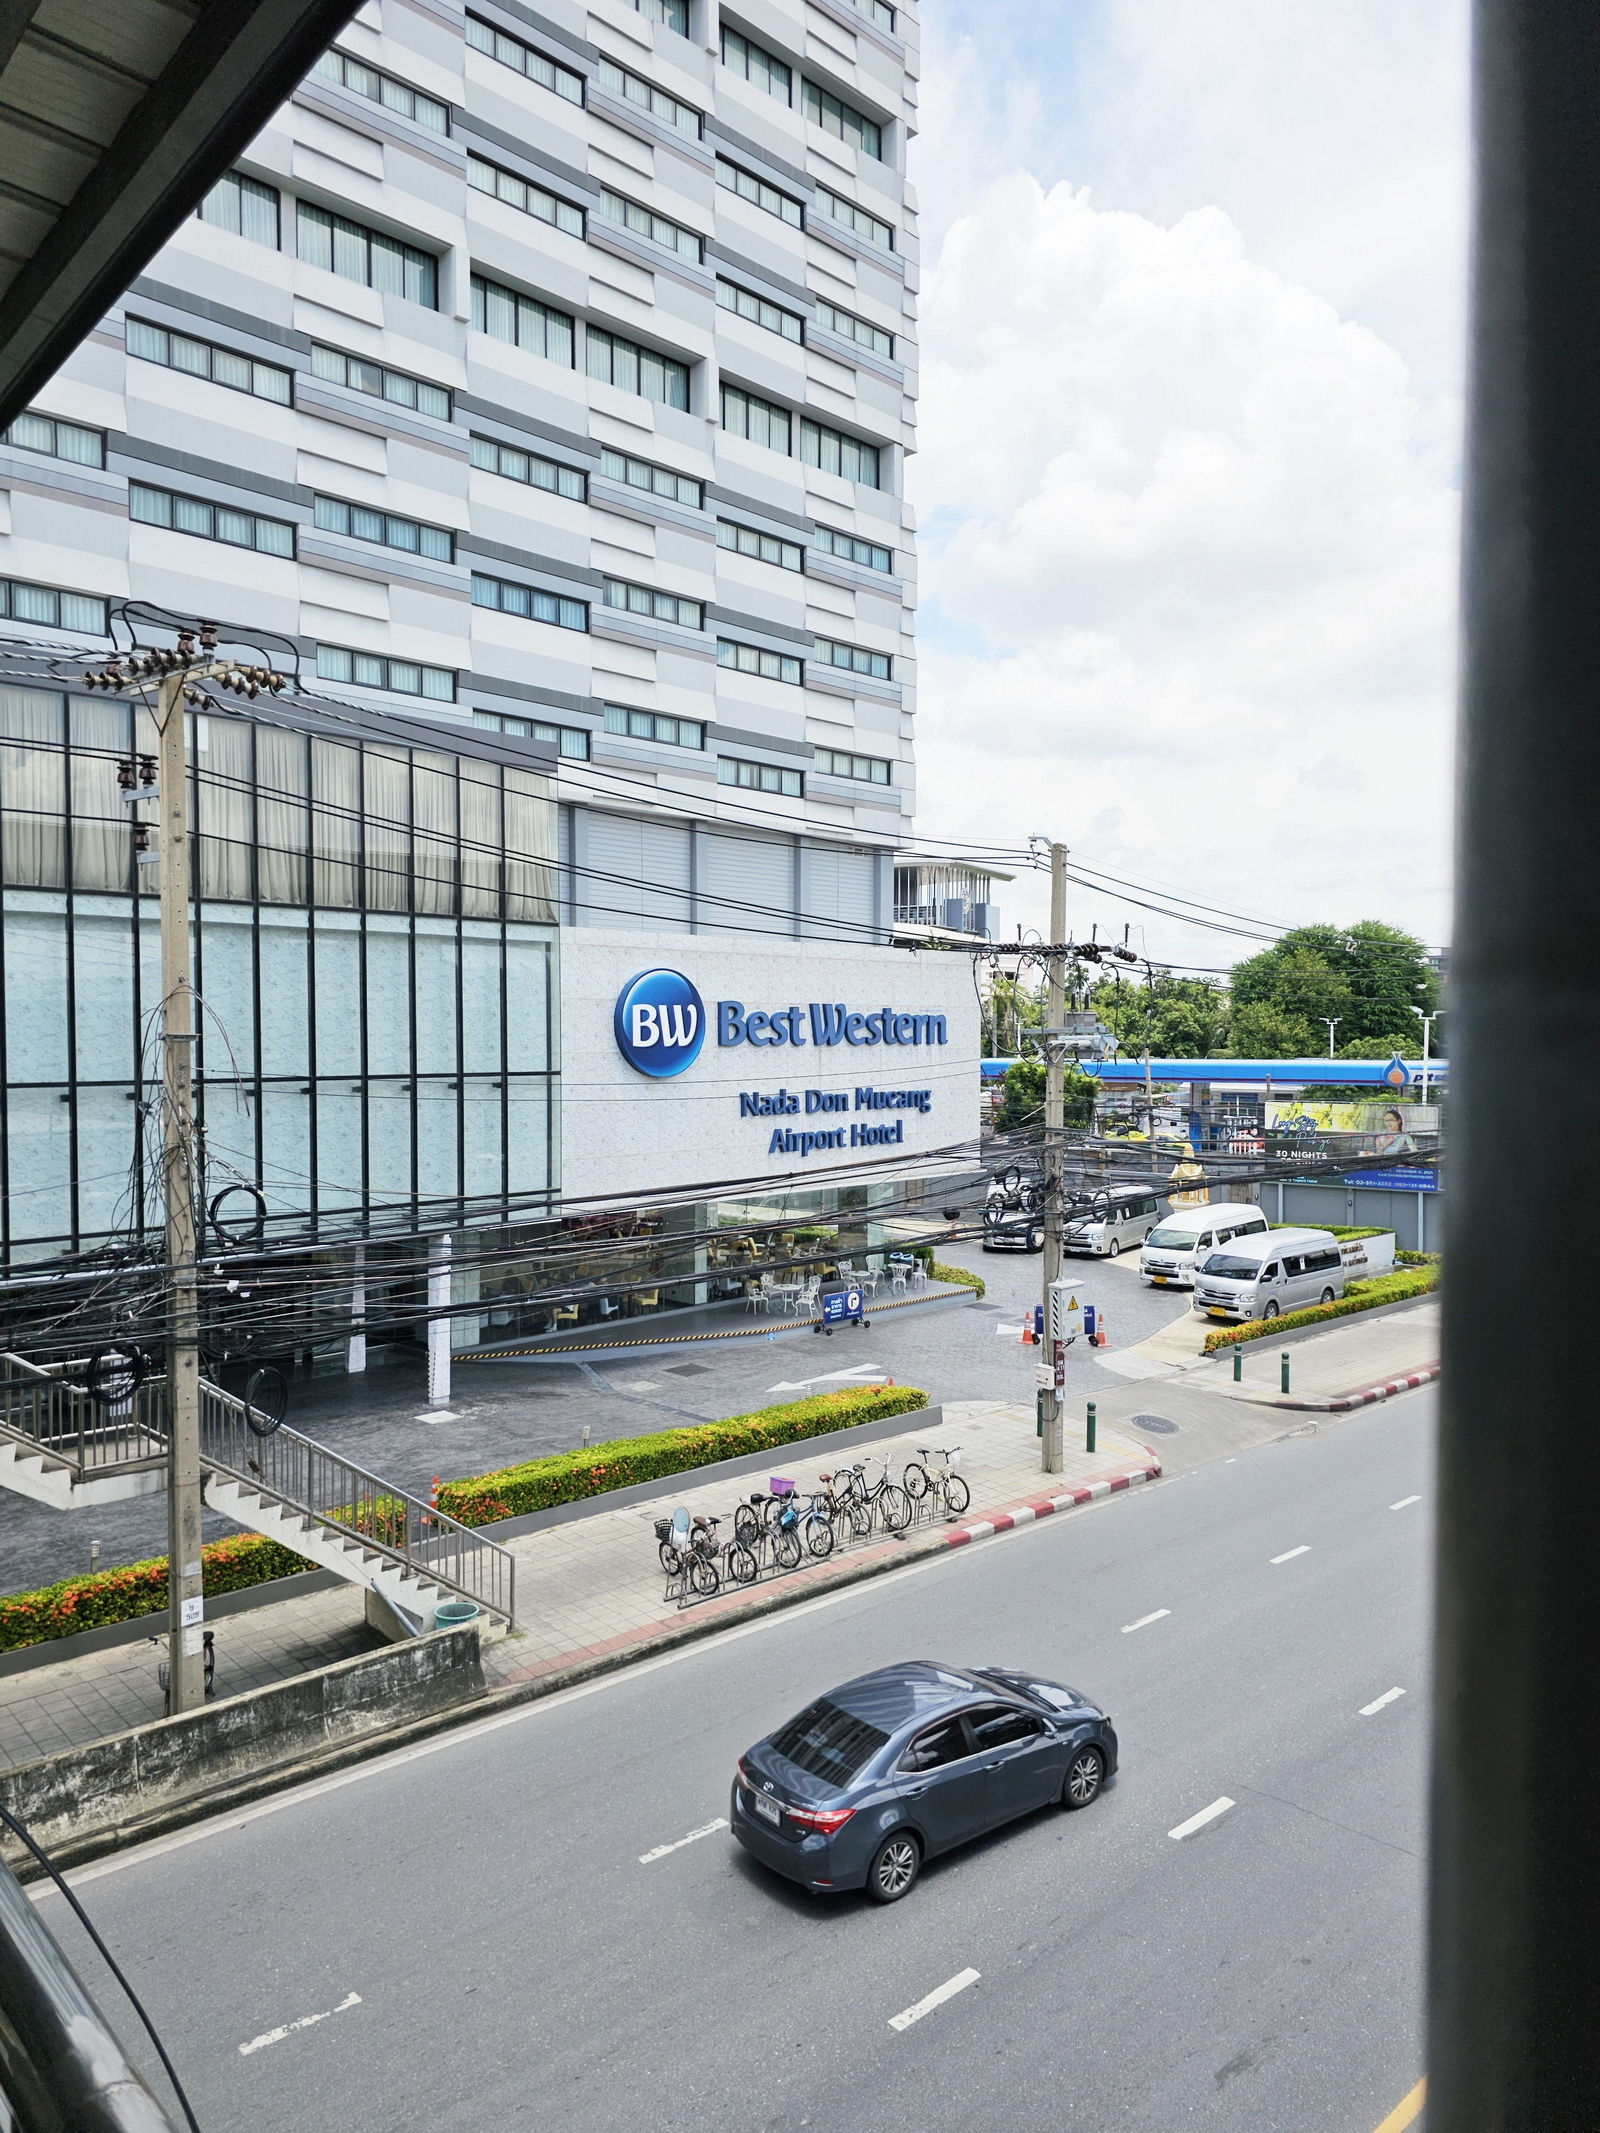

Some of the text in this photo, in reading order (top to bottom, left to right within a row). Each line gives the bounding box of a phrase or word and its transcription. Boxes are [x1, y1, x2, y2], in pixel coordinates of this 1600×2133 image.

[632, 1004, 697, 1047] BW
[717, 1000, 949, 1047] Best Western
[739, 1087, 932, 1118] Nada Don Mueang
[768, 1119, 904, 1157] Airport Hotel
[1275, 1149, 1328, 1159] 30 NIGHTS
